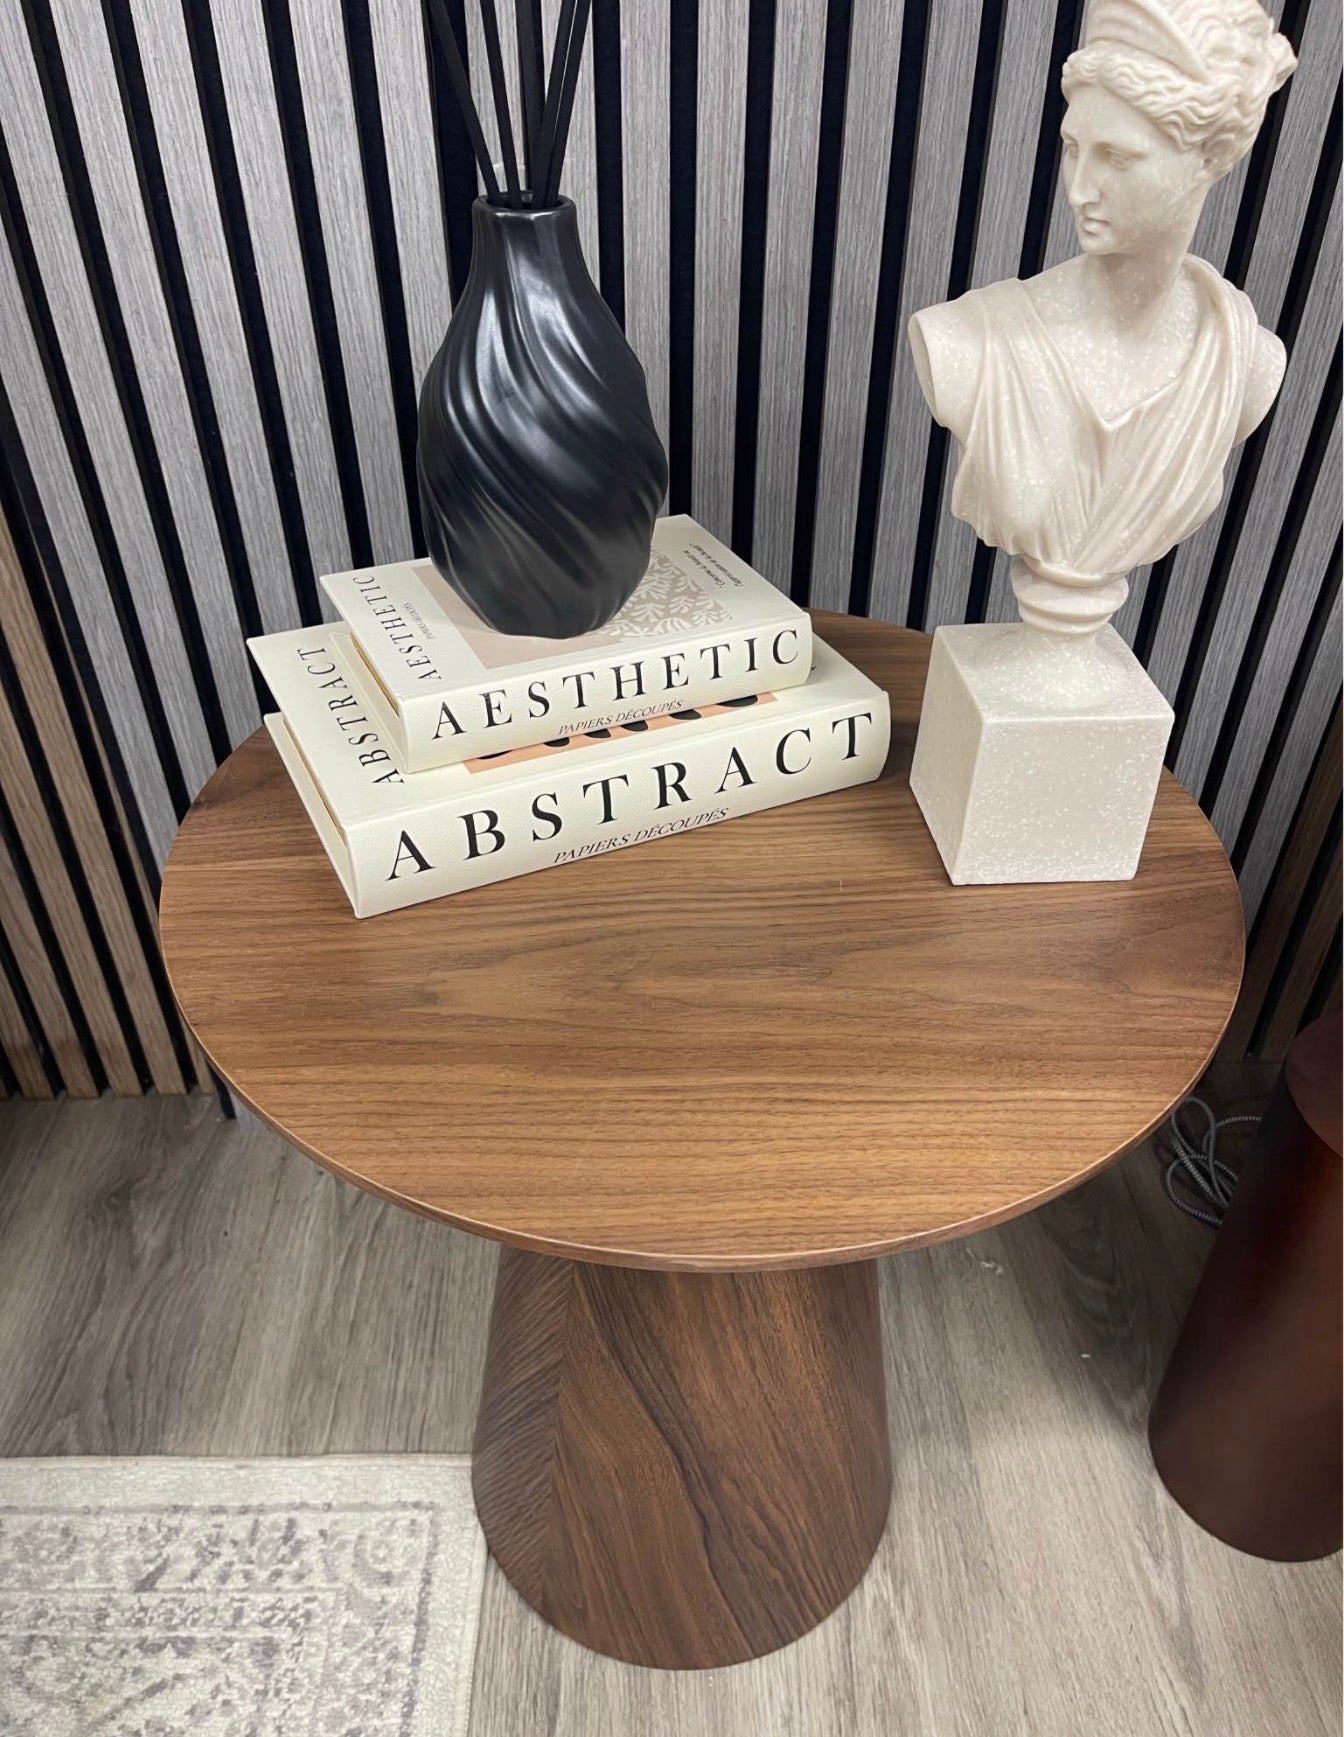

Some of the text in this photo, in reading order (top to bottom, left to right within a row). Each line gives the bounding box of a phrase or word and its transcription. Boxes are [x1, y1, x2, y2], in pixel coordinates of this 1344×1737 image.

[352, 574, 443, 681] AESTHETIC
[296, 647, 406, 784] ABSTRACT
[431, 629, 800, 740] AESTHETIC
[558, 715, 612, 735] PAPIERS
[386, 713, 873, 882] ABSTRACT
[554, 806, 729, 863] PAPIERS DÉCOUPÉS
